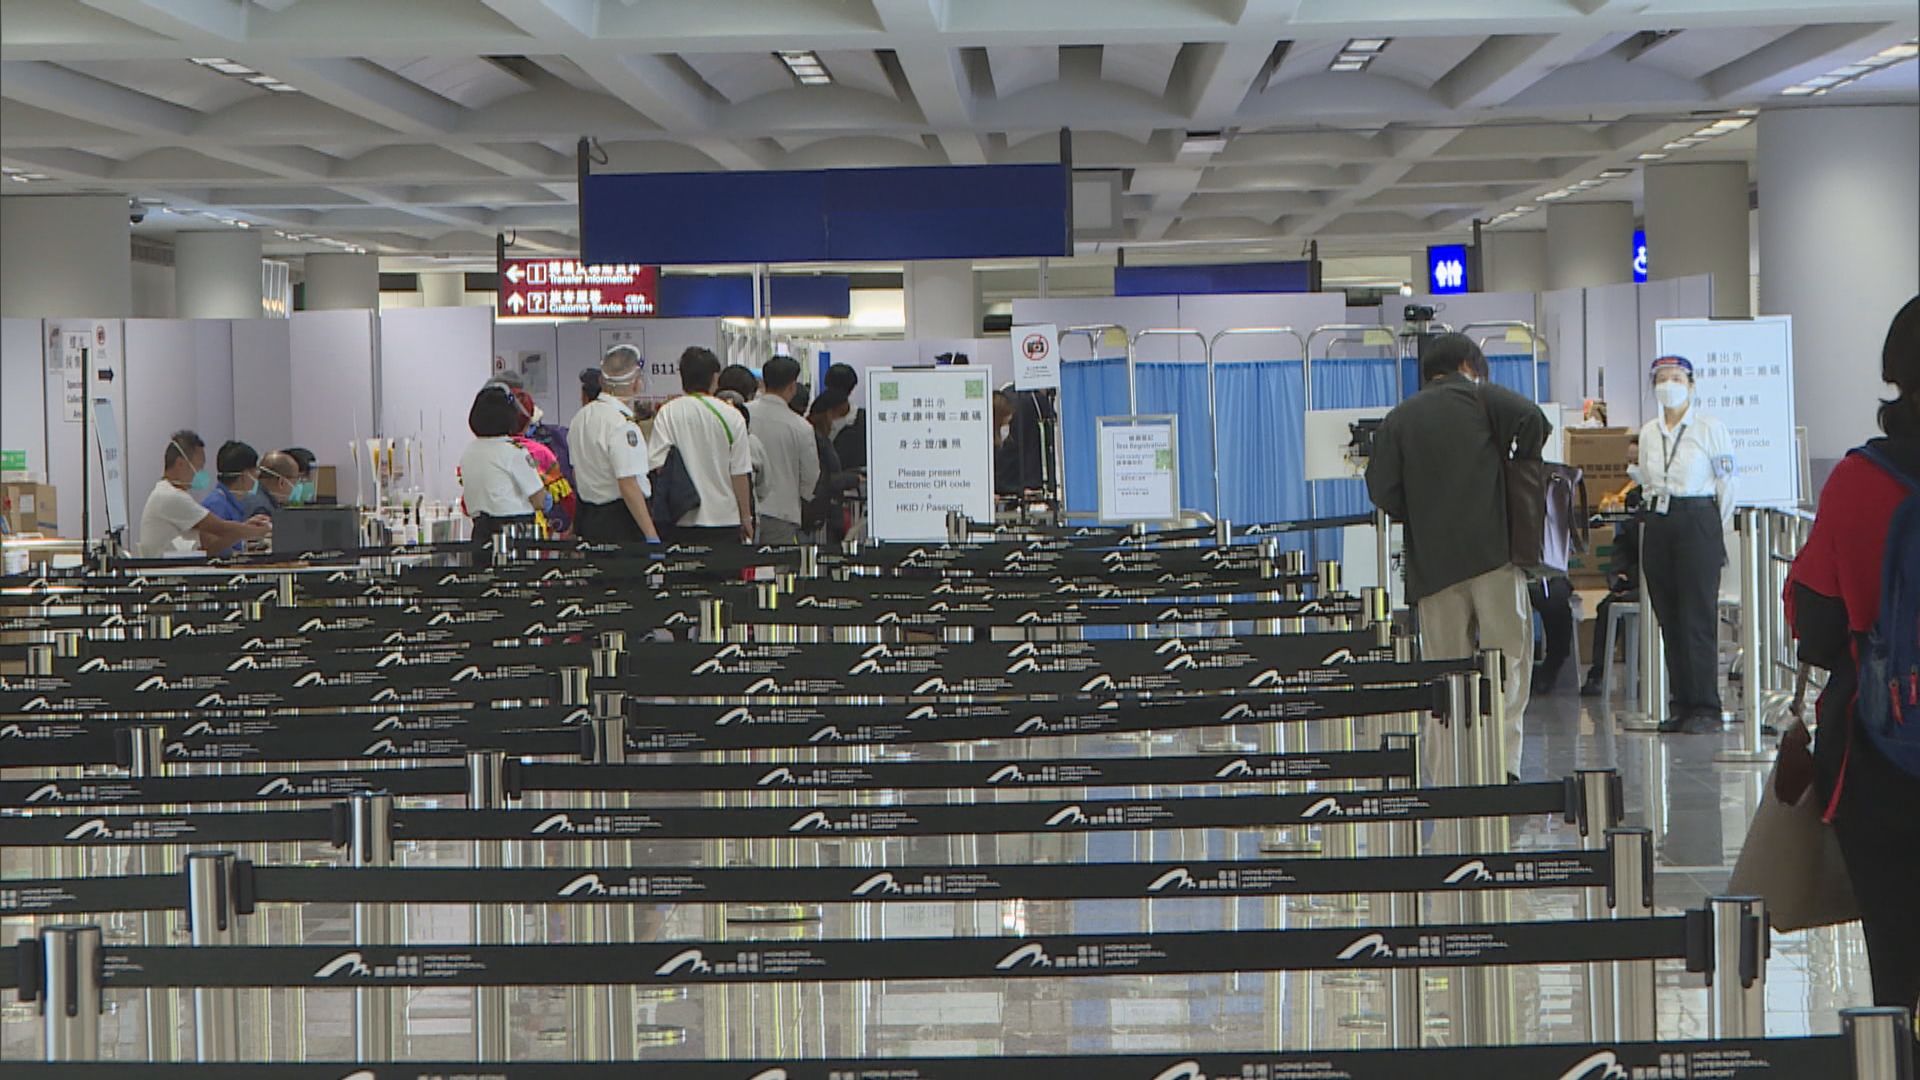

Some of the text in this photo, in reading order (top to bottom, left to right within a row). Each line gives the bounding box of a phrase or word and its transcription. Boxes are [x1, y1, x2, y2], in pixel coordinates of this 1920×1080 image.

[549, 275, 633, 285] Transfer Information
[550, 303, 590, 313] Customer
[592, 302, 623, 313] Service
[1695, 365, 1780, 378] 健康申報二維碼
[913, 397, 945, 408] 請出示
[1729, 427, 1760, 436] resent
[1748, 438, 1770, 447] code
[898, 468, 961, 479] Please present
[888, 480, 971, 489] Electronic QR code
[897, 504, 918, 512] HKID
[926, 503, 964, 513] Passport
